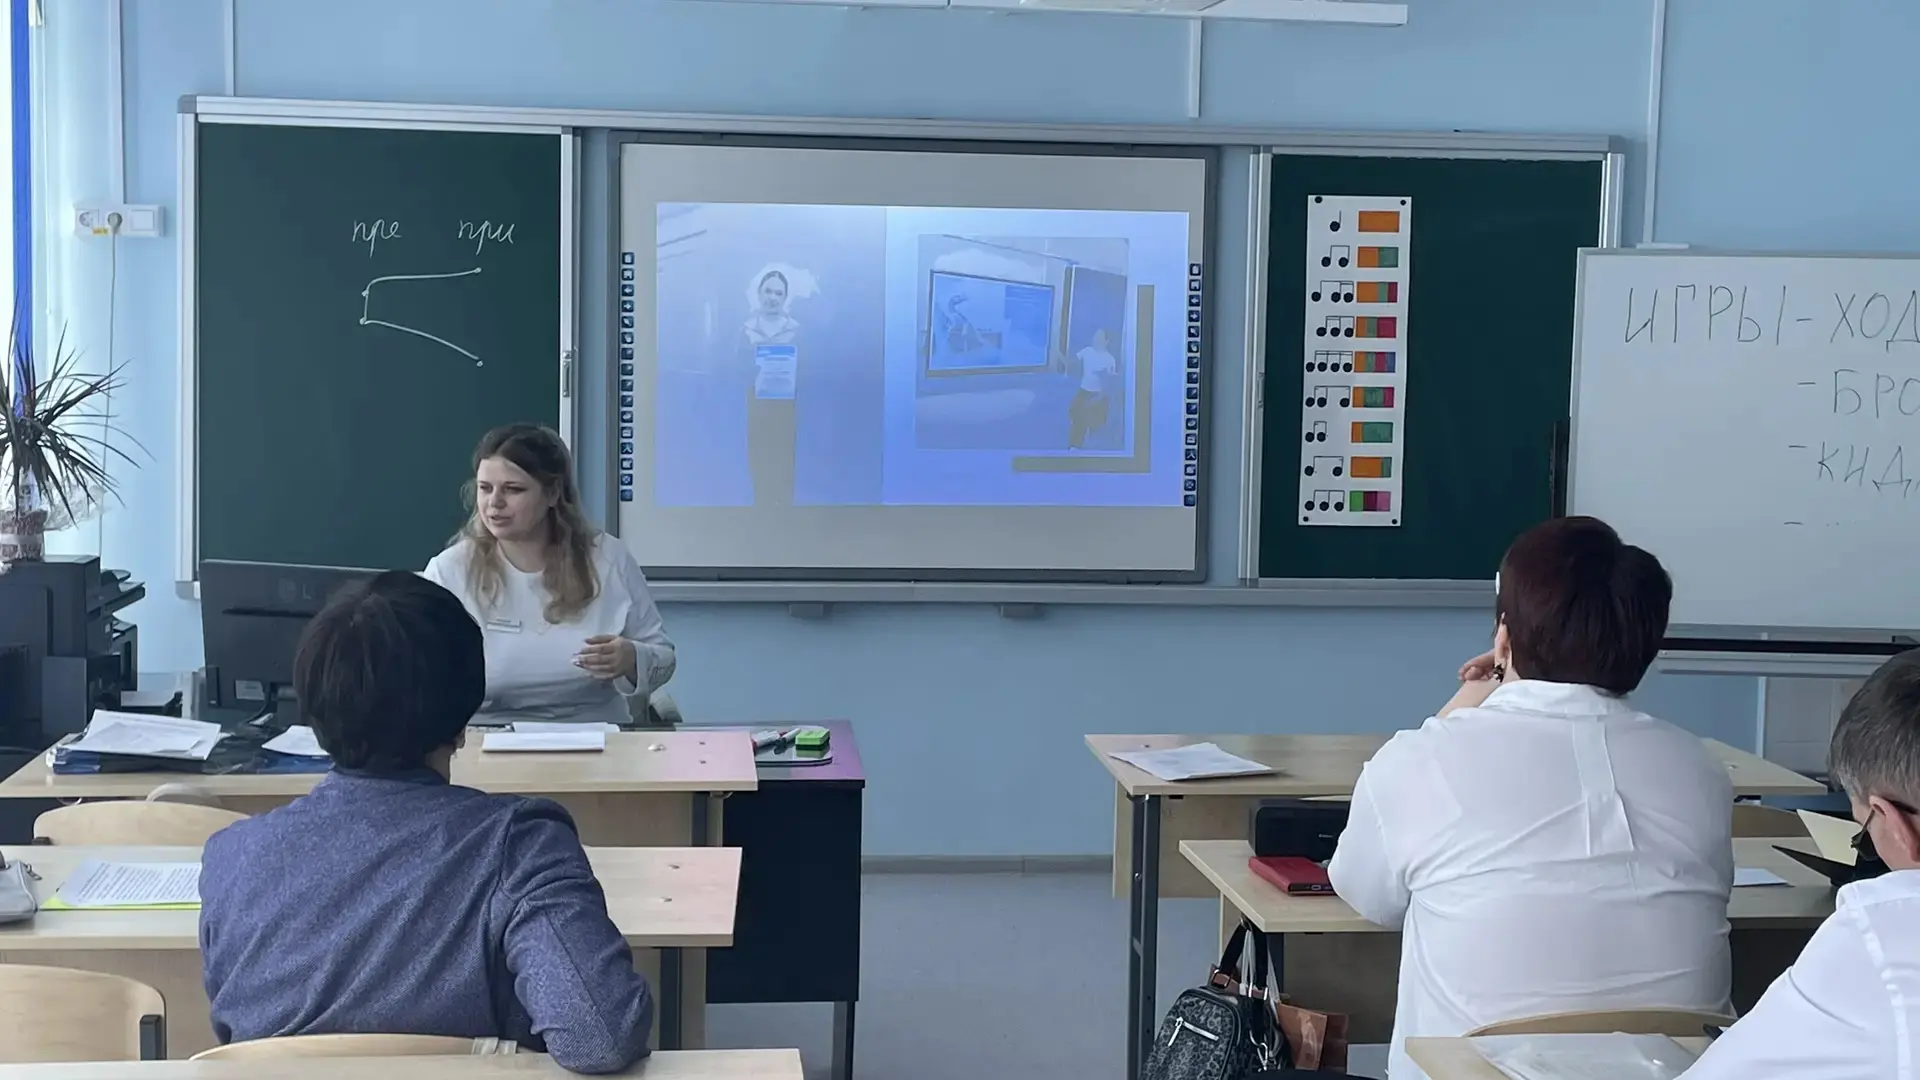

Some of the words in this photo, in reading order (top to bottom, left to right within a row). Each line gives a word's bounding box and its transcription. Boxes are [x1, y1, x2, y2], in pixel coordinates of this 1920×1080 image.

[352, 218, 402, 258] пре
[457, 219, 515, 256] при
[1817, 441, 1920, 499] КИД
